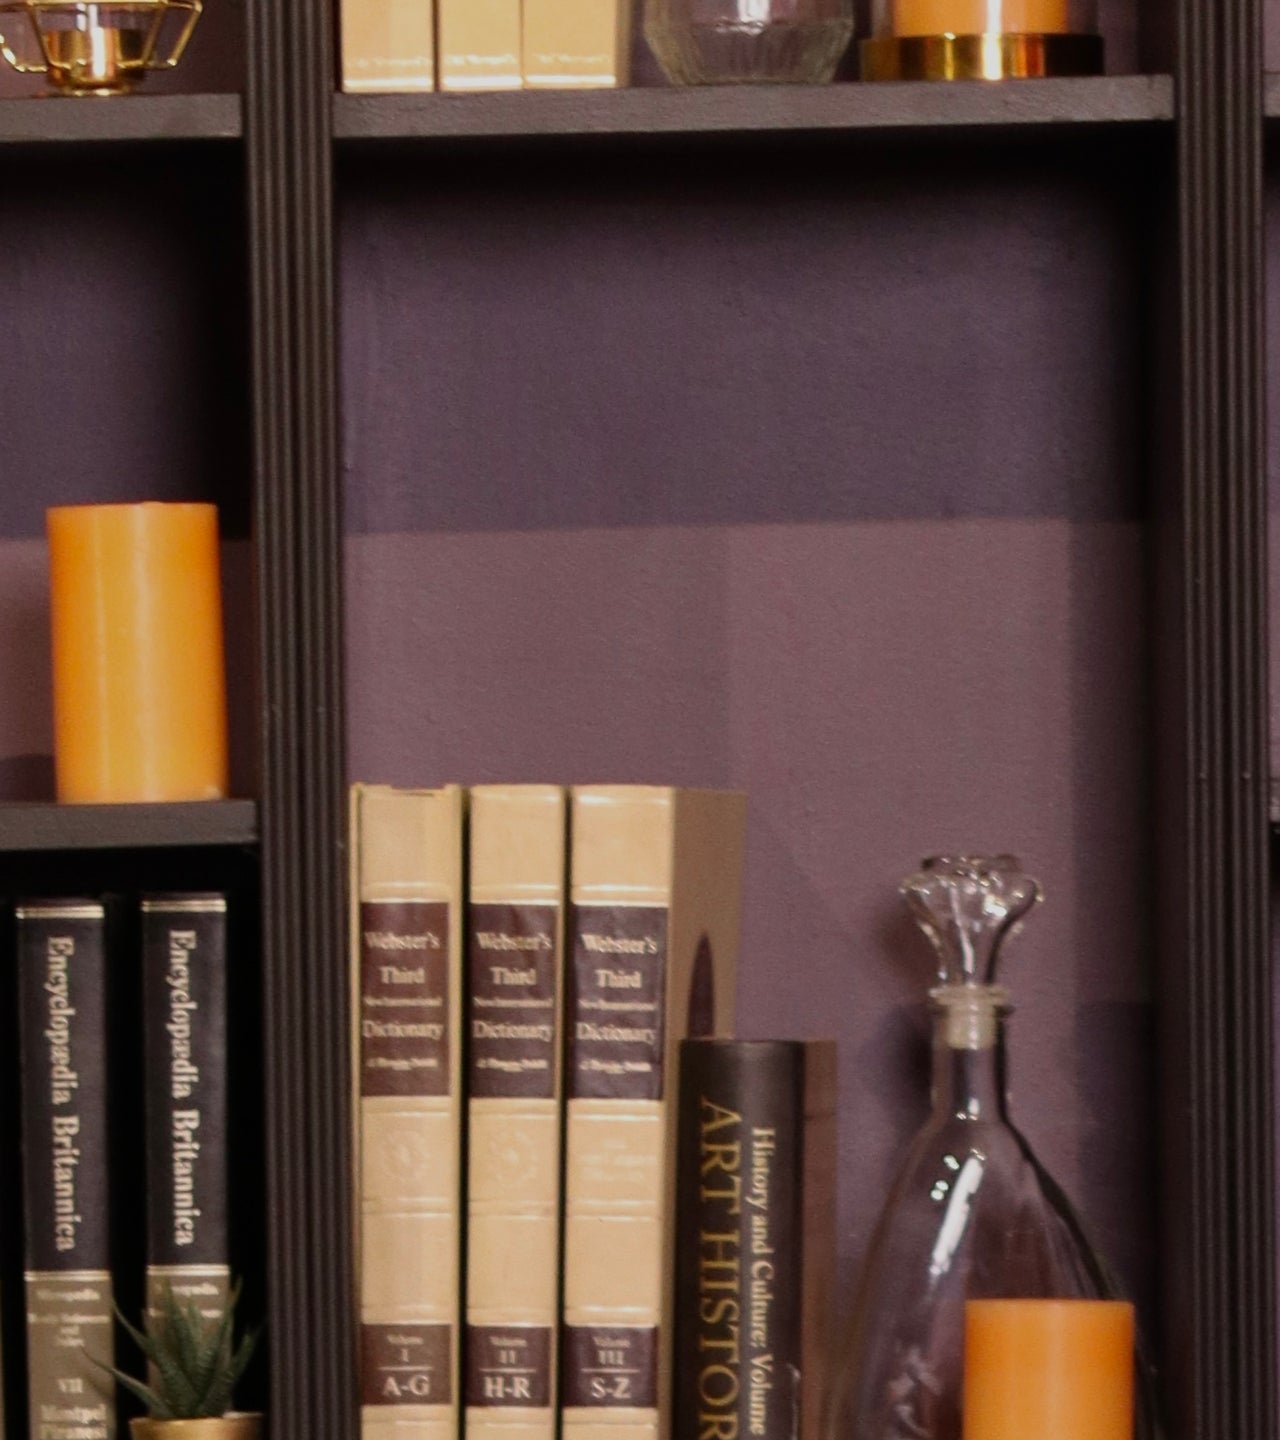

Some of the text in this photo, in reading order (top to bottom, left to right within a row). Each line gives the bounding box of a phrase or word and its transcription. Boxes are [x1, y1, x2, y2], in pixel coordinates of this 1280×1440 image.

[365, 931, 440, 950] Webster's
[476, 931, 552, 950] Webster's
[581, 933, 657, 954] Webster's
[380, 966, 425, 984] Third
[490, 966, 537, 986] Third
[596, 968, 642, 989] Third
[363, 1020, 443, 1041] Dictionary
[473, 1020, 552, 1043] Dictionary
[576, 1022, 656, 1045] Dictionary
[700, 1095, 742, 1216] ART
[173, 1109, 201, 1246] Britannica
[745, 1127, 776, 1210] History
[53, 1115, 82, 1250] Britannica
[750, 1215, 774, 1254] and
[399, 1348, 410, 1362] I
[499, 1350, 517, 1364] II
[598, 1350, 624, 1365] III
[383, 1374, 430, 1396] A-G
[484, 1376, 530, 1398] H-R
[591, 1376, 631, 1399] S-Z
[750, 1353, 774, 1437] Volume
